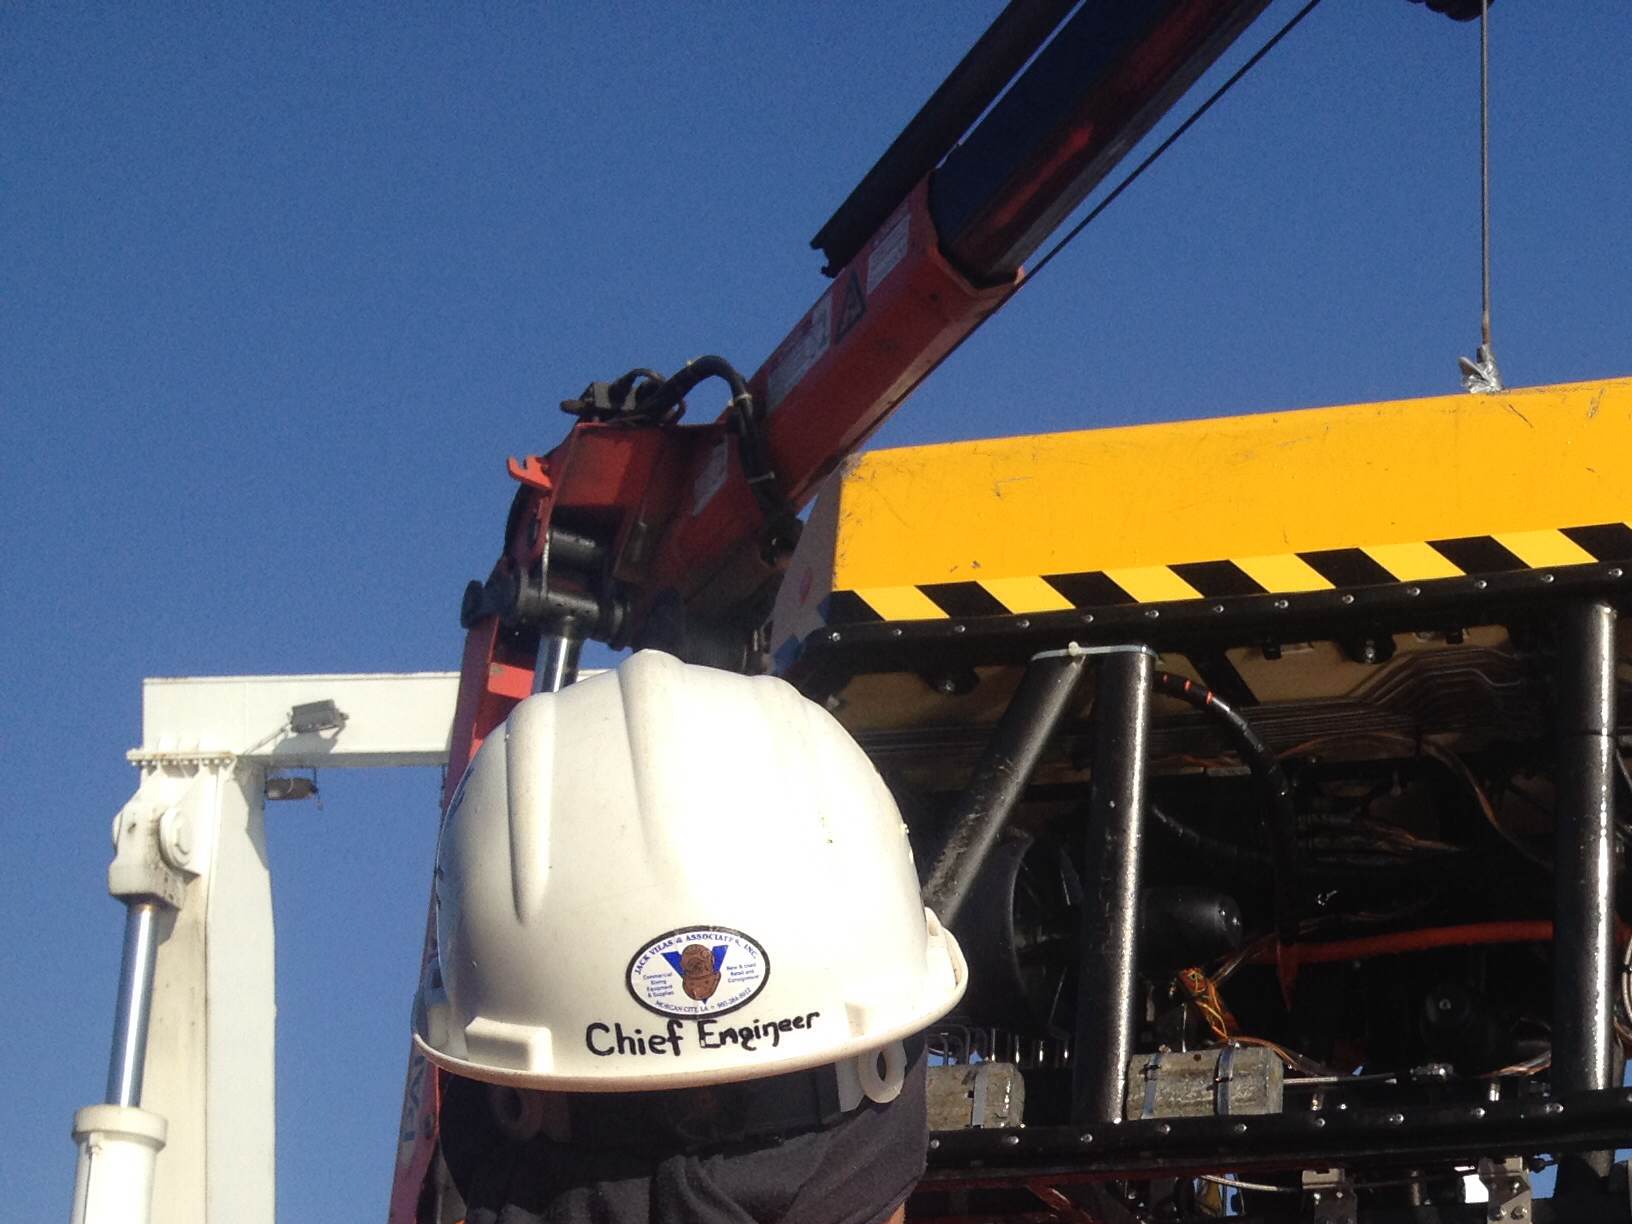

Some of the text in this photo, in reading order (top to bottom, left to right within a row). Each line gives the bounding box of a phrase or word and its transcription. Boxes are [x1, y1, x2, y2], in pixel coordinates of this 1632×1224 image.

[634, 954, 651, 976] JACK
[649, 939, 674, 956] VILAS
[585, 1011, 821, 1057] Chief Engineer
